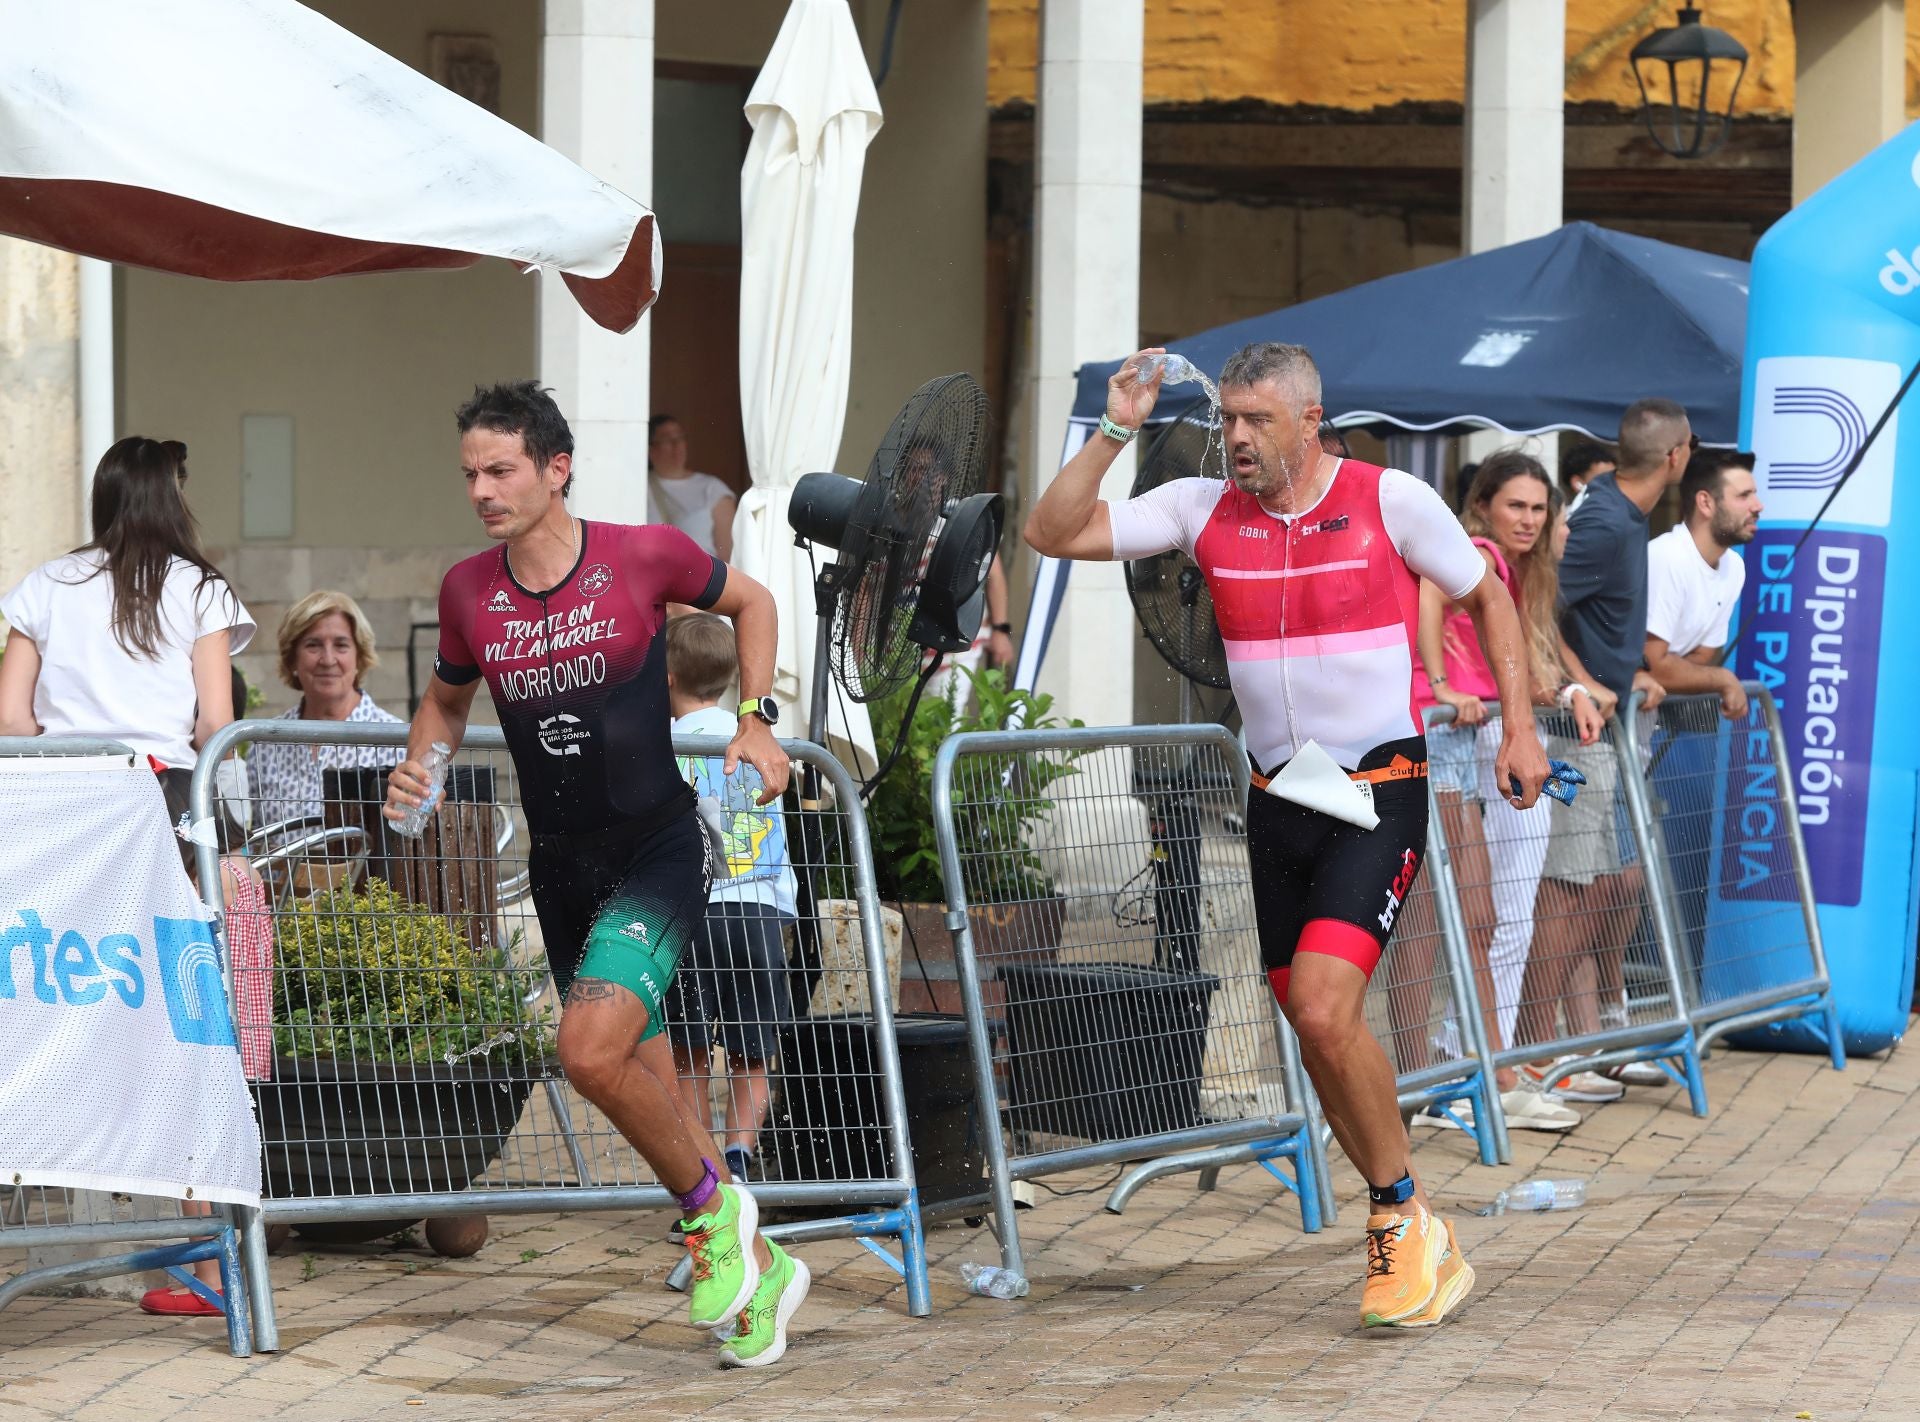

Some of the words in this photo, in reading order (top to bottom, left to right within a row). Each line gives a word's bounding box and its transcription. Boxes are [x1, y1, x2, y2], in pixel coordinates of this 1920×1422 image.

[1239, 525, 1269, 540] GOBIK
[1757, 544, 1797, 614] DE
[484, 617, 622, 663] VILLAMURIEL
[502, 600, 596, 640] TRIATLÓN
[499, 651, 606, 703] MORRONDO
[1799, 545, 1860, 826] Diputación
